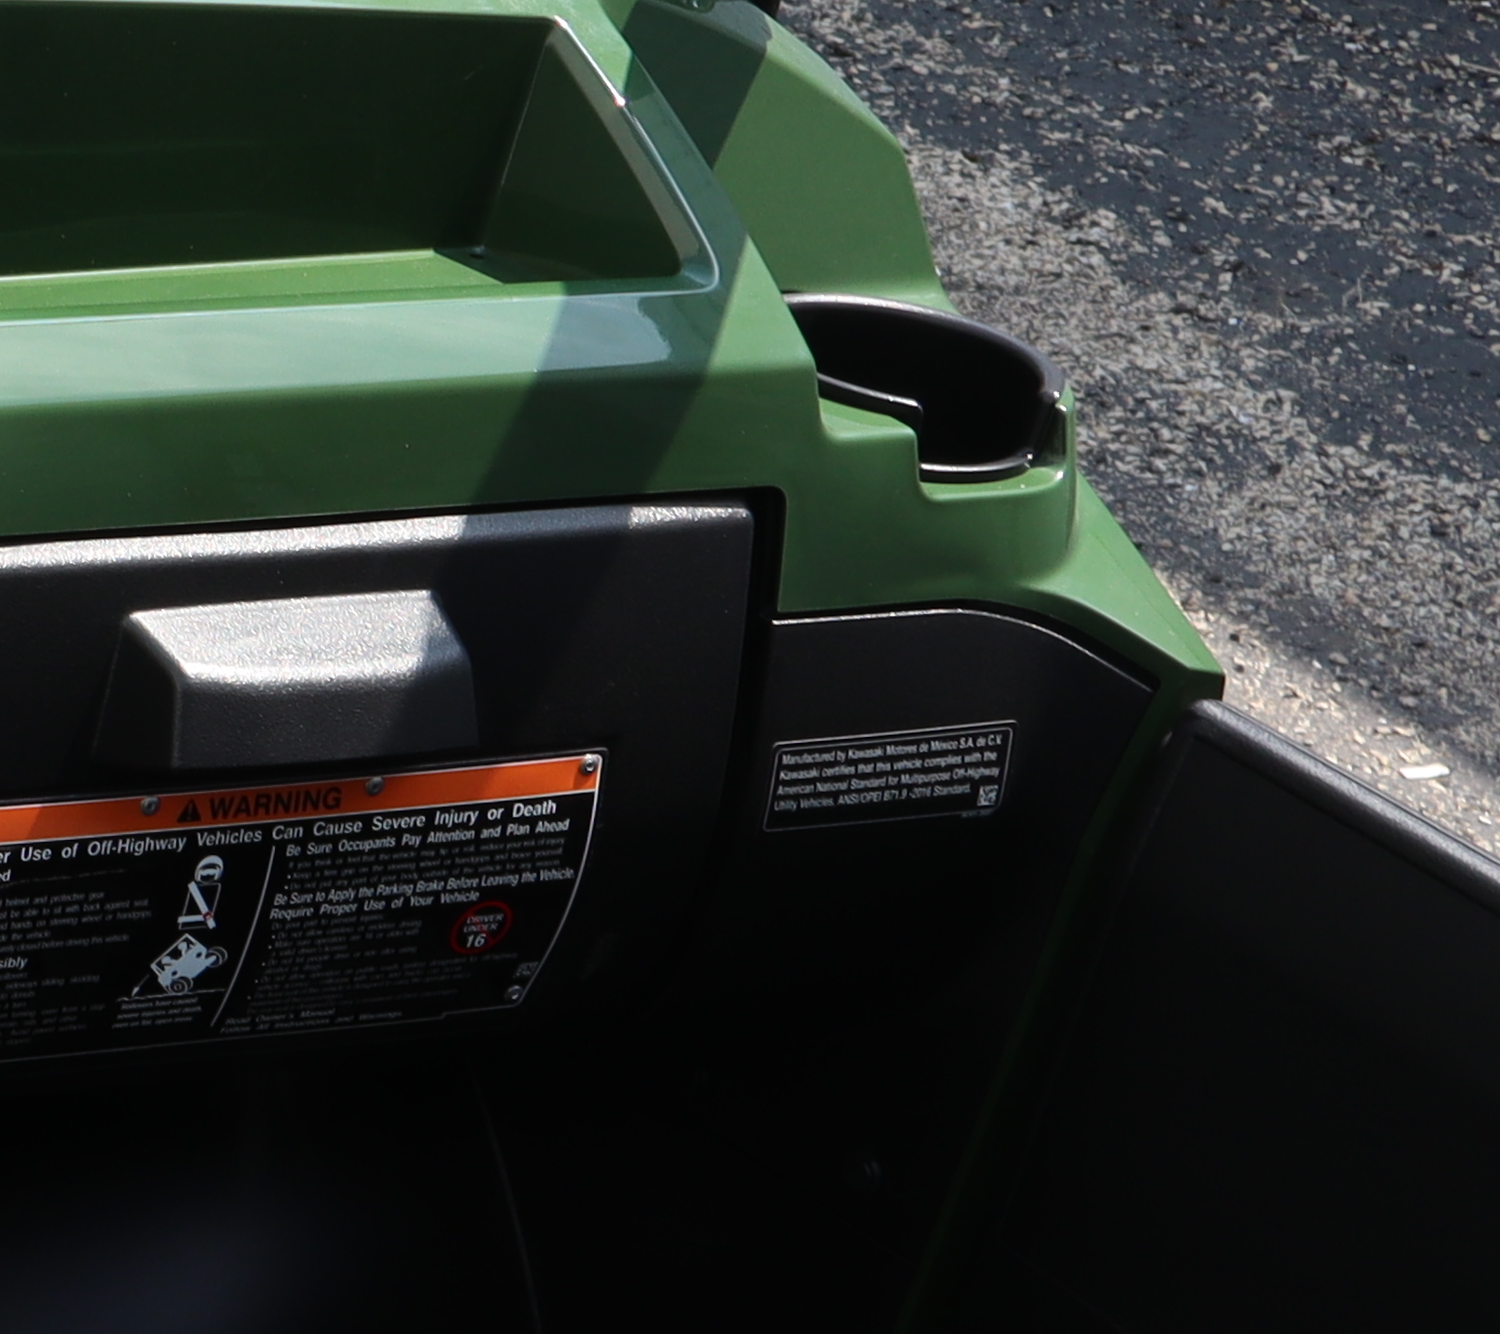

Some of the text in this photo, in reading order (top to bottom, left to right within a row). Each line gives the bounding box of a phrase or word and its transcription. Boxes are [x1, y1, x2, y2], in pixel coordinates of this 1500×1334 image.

[779, 766, 820, 780] Kawasaki
[857, 761, 874, 773] that
[892, 757, 922, 770] vehicle
[923, 754, 962, 768] complies
[963, 752, 982, 764] with
[982, 750, 997, 762] the
[207, 787, 344, 819] WARNING
[19, 845, 52, 863] Use
[61, 843, 78, 859] of
[86, 833, 187, 860] Off-Highway
[194, 826, 263, 847] Vehicles
[270, 822, 304, 840] Can
[313, 817, 363, 836] Cause
[371, 811, 427, 830] Severe
[433, 806, 479, 828] Injury
[486, 808, 503, 820] or
[511, 799, 558, 817] Death
[285, 818, 569, 856] Be Sure Occupants Pay Attention and Plan Ahead
[273, 893, 287, 906] Be
[290, 891, 313, 904] Sure
[315, 889, 326, 902] to
[327, 887, 355, 904] Apply
[358, 885, 374, 898] the
[375, 881, 414, 899] Parking
[416, 878, 444, 892] Brake
[446, 875, 479, 889] Before
[480, 871, 520, 889] Leaving
[521, 869, 537, 882] the
[268, 889, 480, 922] Require Proper Use of Your Vehicle
[466, 913, 504, 923] DRIVER
[462, 922, 497, 933] UNDER
[465, 933, 485, 948] 16
